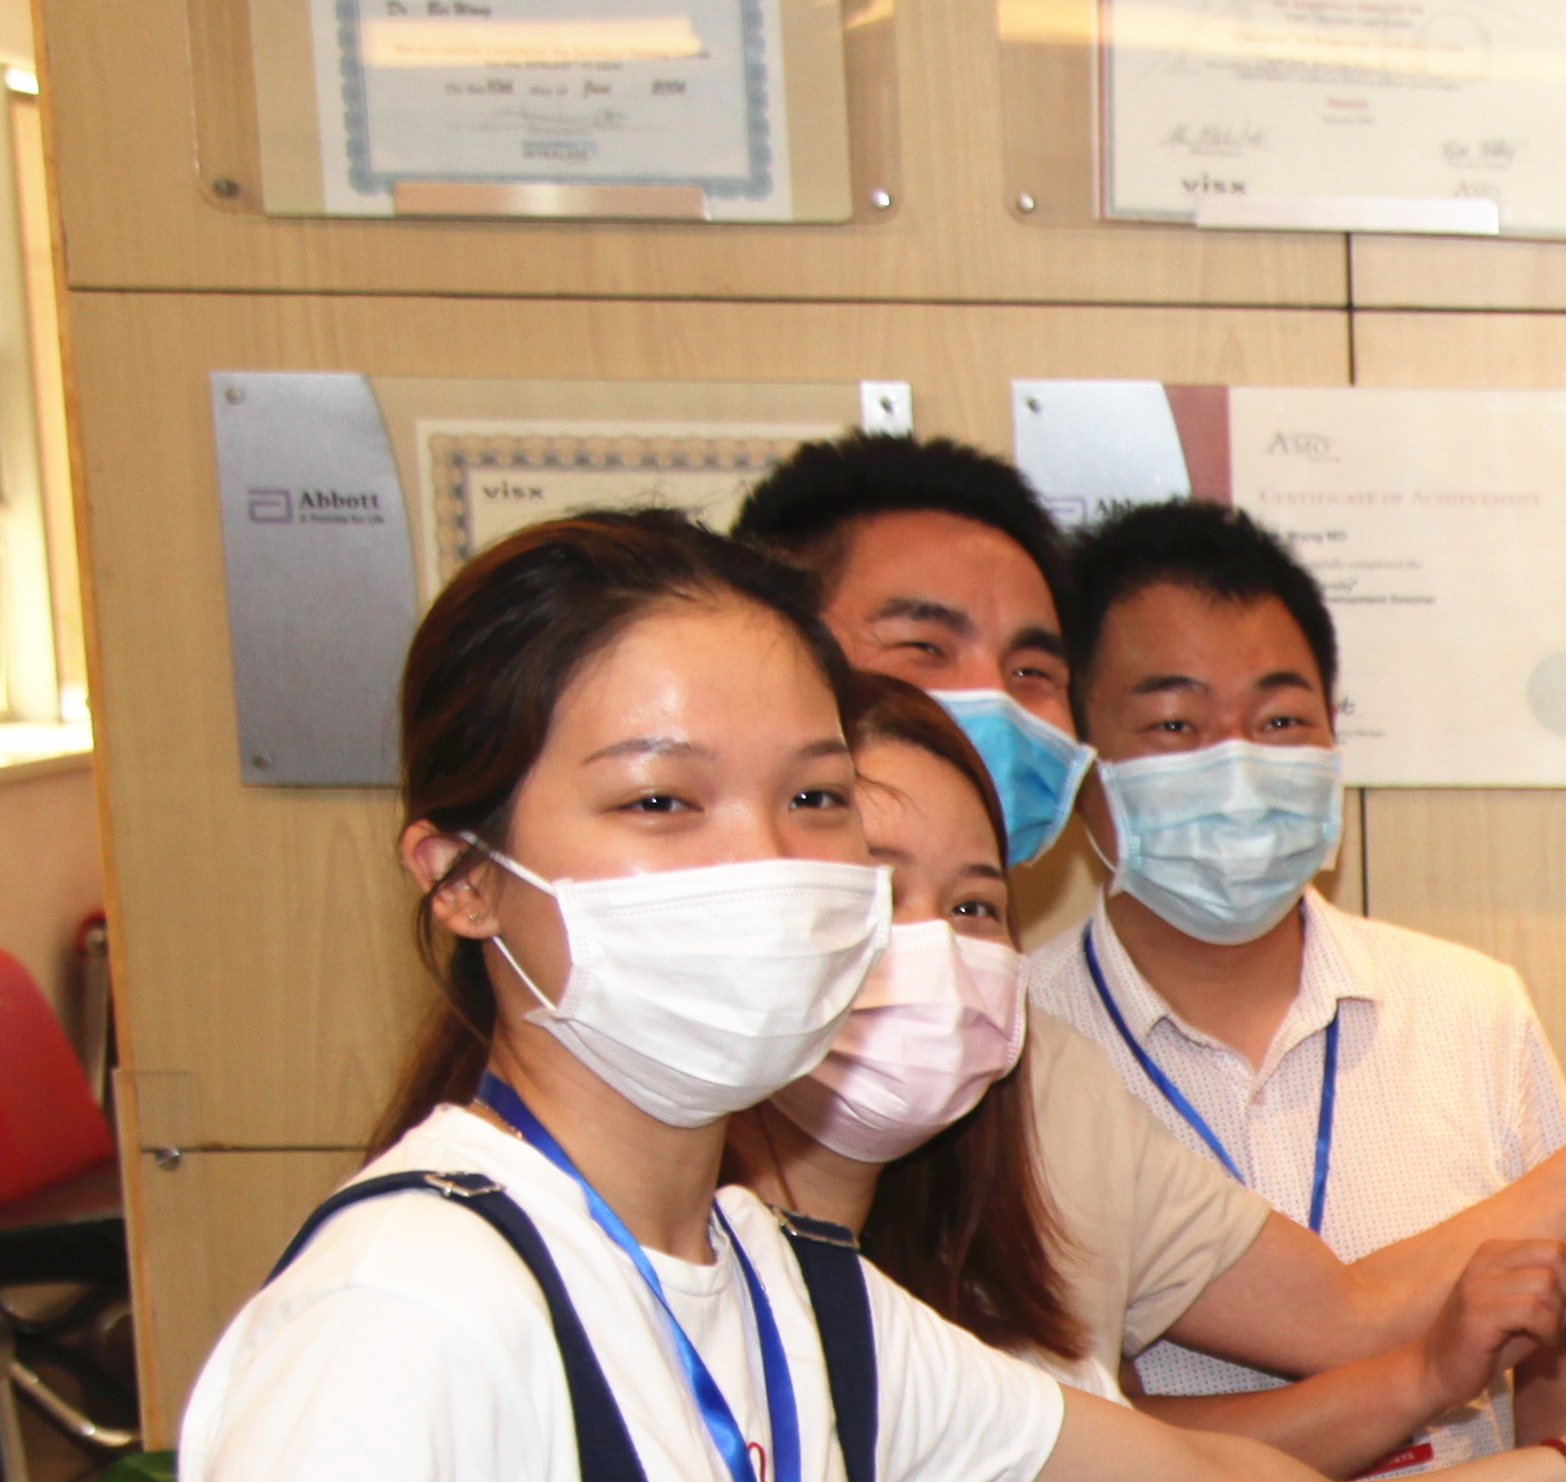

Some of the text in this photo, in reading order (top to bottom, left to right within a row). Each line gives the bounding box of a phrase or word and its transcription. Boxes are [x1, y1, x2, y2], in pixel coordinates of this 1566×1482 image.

[1181, 173, 1247, 194] visx
[300, 490, 380, 510] Abbott
[483, 484, 545, 500] visx
